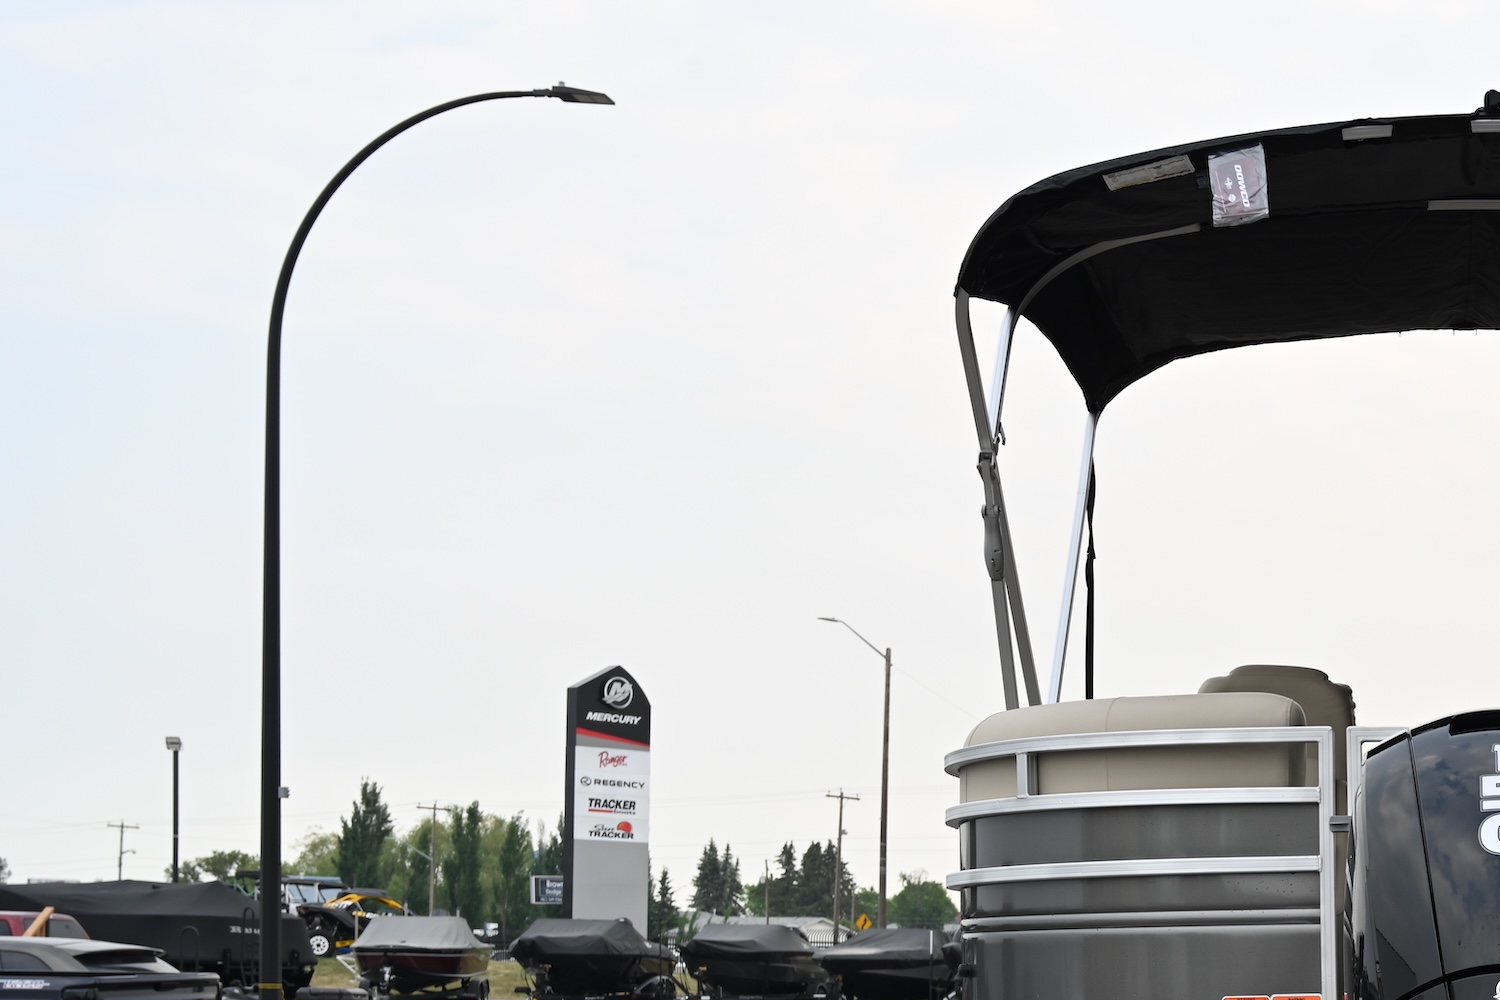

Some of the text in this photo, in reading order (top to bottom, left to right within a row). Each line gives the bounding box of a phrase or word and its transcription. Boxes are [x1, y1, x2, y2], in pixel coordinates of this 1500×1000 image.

[586, 711, 642, 725] MERCURY
[594, 778, 646, 789] REGENCY
[588, 797, 637, 811] TRACKER
[588, 830, 634, 839] TRACKER
